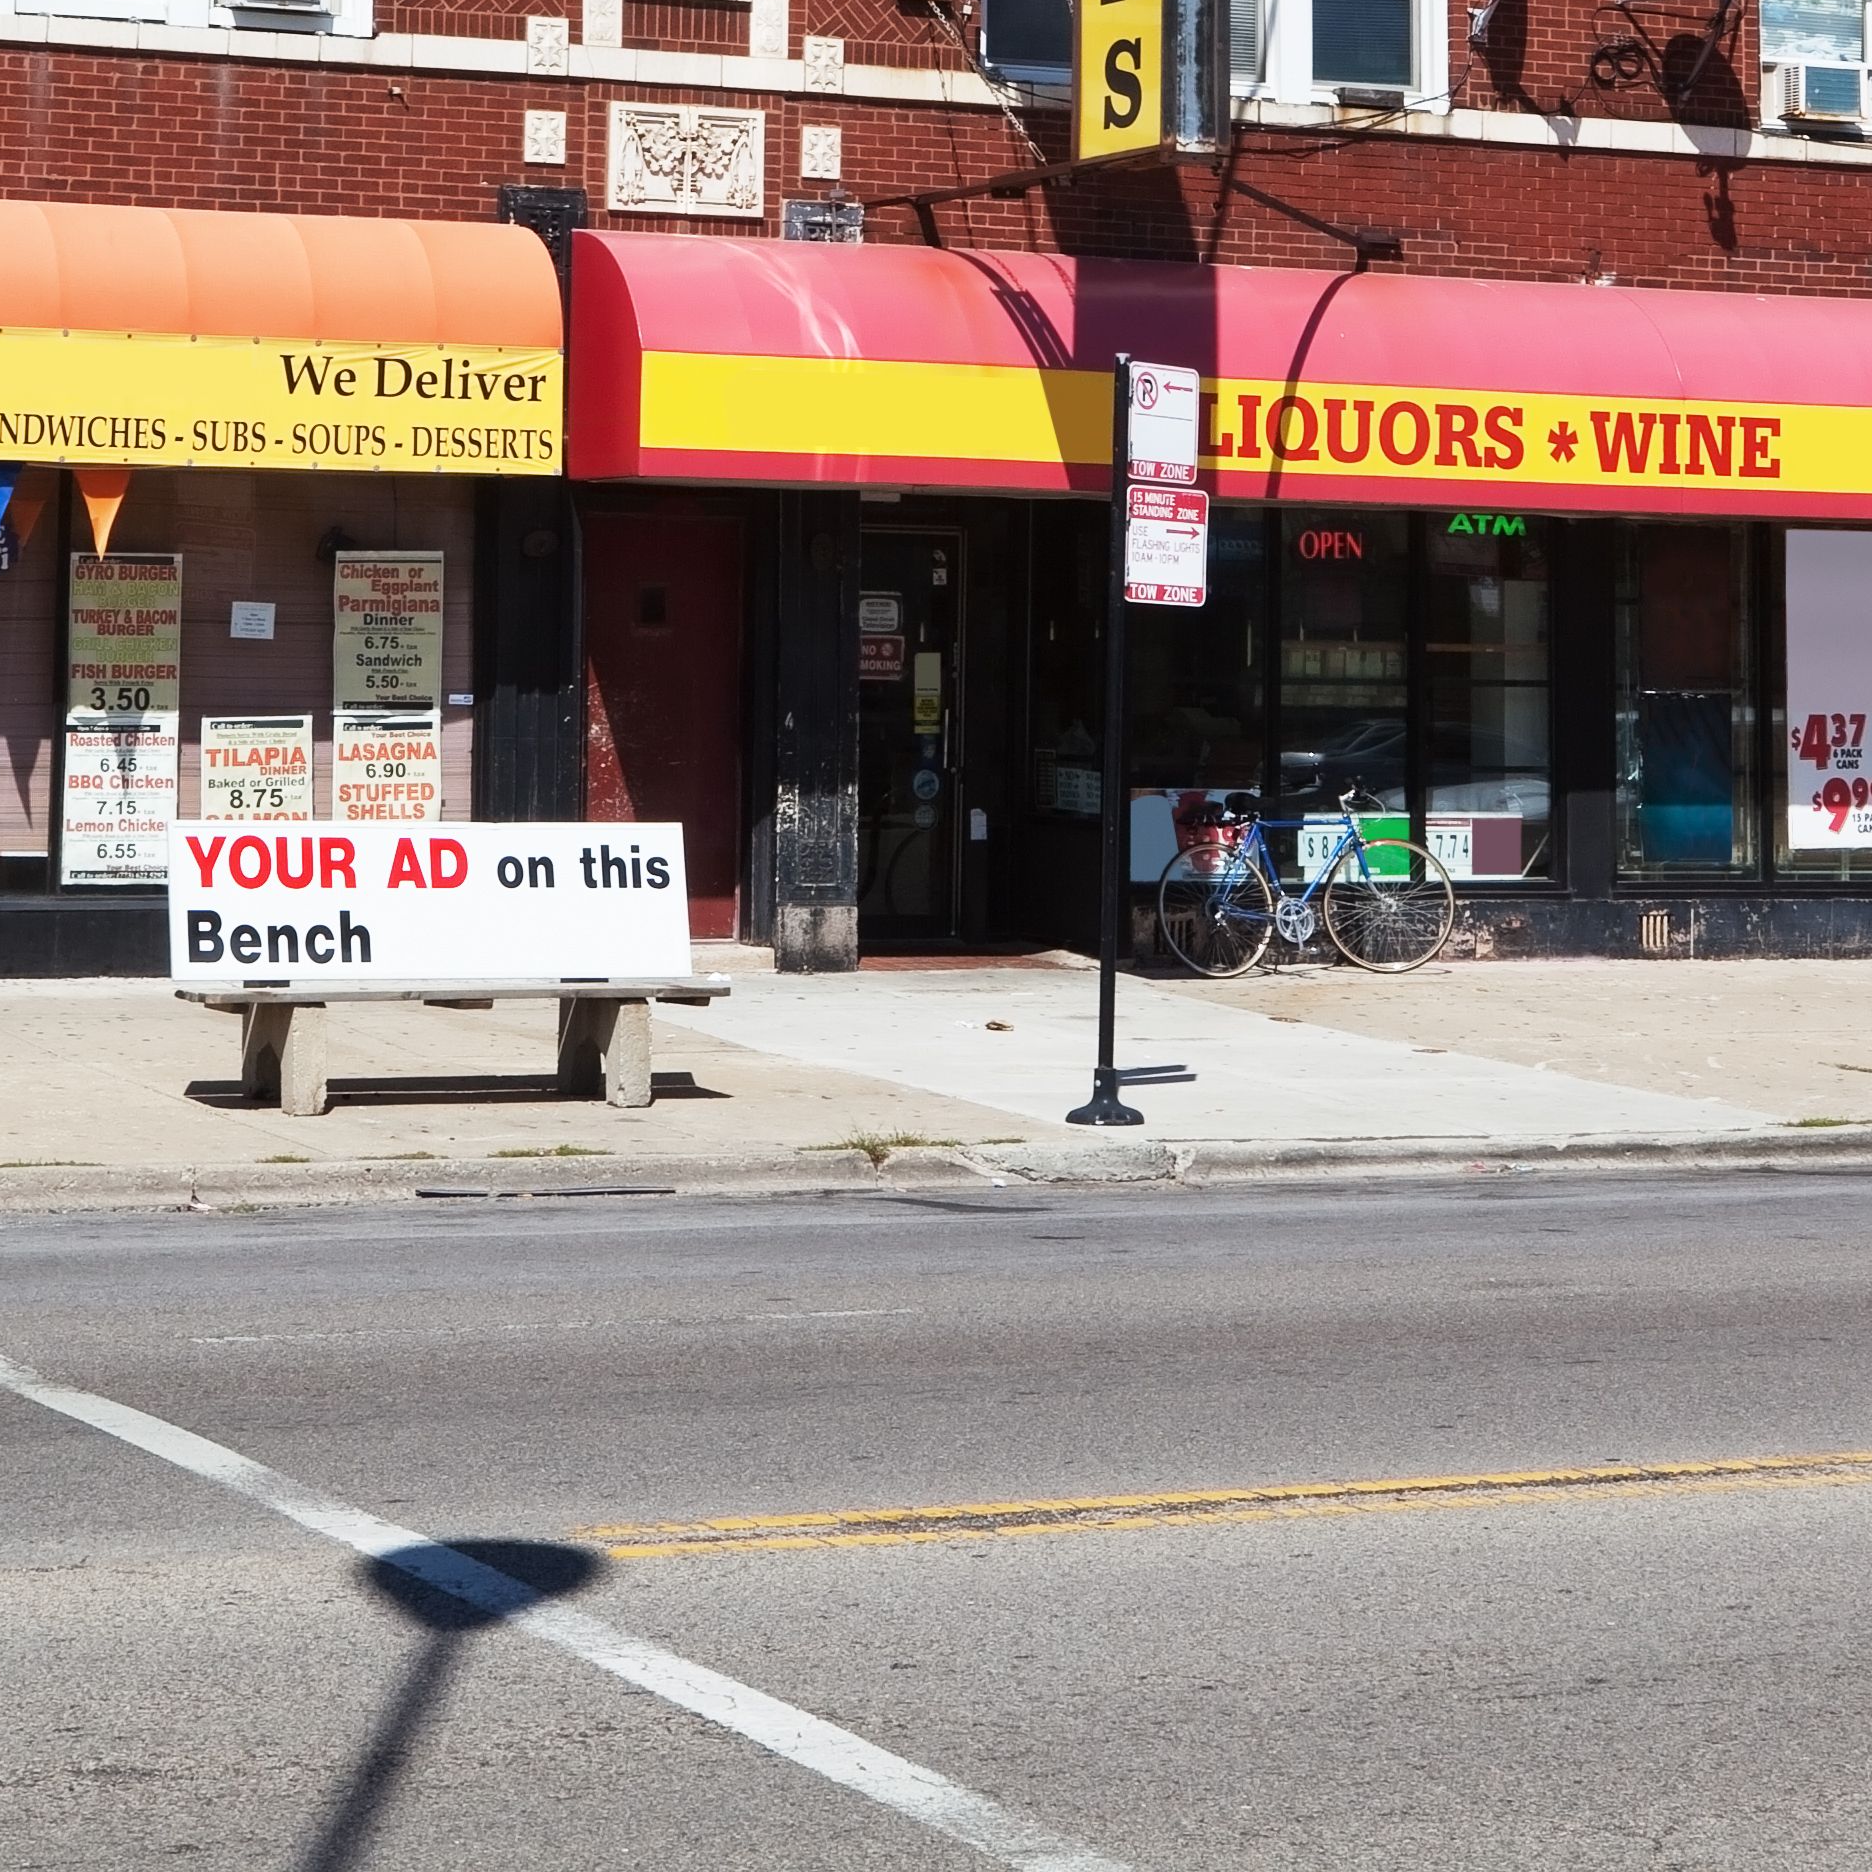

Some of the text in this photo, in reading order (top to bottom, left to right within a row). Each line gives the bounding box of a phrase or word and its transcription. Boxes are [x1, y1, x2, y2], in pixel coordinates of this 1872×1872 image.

[280, 354, 547, 402] We Deliver
[192, 420, 266, 453] SUBS
[292, 423, 386, 456] SOUPS
[412, 426, 553, 459] DESSERTS
[1199, 392, 1781, 478] LIQUORS WINE
[1133, 461, 1190, 480] TOW ZONE
[1133, 492, 1143, 503] 15
[1145, 493, 1176, 506] MINUTE
[1133, 505, 1199, 521] STANDING ZONE
[1132, 525, 1148, 537] USE
[1448, 512, 1526, 536] ATM
[1132, 538, 1170, 552] FLASHING
[1174, 541, 1201, 554] LIGHTS
[1299, 530, 1363, 559] OPEN
[75, 566, 177, 581] GYRO BURGER
[340, 564, 424, 579] Chicken or
[73, 582, 106, 596] HAM
[128, 581, 179, 596] BACON
[371, 580, 439, 594] Eggplant
[1130, 584, 1198, 602] TOW ZONE
[338, 595, 440, 616] Parmigiana
[73, 609, 177, 624] TURKEY & BACON
[363, 613, 415, 626] Dinner
[97, 624, 155, 636] BURGER
[364, 636, 399, 649] 6.75
[861, 644, 877, 655] NO
[356, 653, 422, 667] Sandwich
[860, 660, 901, 671] MOKING
[71, 664, 177, 679] FISH BURGER
[366, 675, 399, 688] 5.50
[91, 687, 150, 711] 3.50
[70, 732, 175, 746] Roasted Chicken
[205, 747, 307, 767] TILAPIA
[338, 742, 437, 761] LASAGNA
[1833, 748, 1863, 759] 6 PACK
[100, 758, 137, 772] 6.45
[260, 765, 307, 776] DINNER
[366, 763, 406, 778] 6.90
[1836, 759, 1859, 770] CANS
[68, 775, 174, 789] BBQ Chicken
[208, 778, 245, 789] Baked
[266, 777, 305, 787] Grilled
[230, 788, 283, 809] 8.75
[339, 783, 435, 802] STUFFED
[96, 801, 137, 815] 7.15
[347, 803, 425, 820] SHELLS
[66, 819, 113, 832] Lemon
[96, 844, 137, 858] 6.55
[185, 835, 671, 889] YOUR AD on this
[187, 910, 371, 964] Bench
